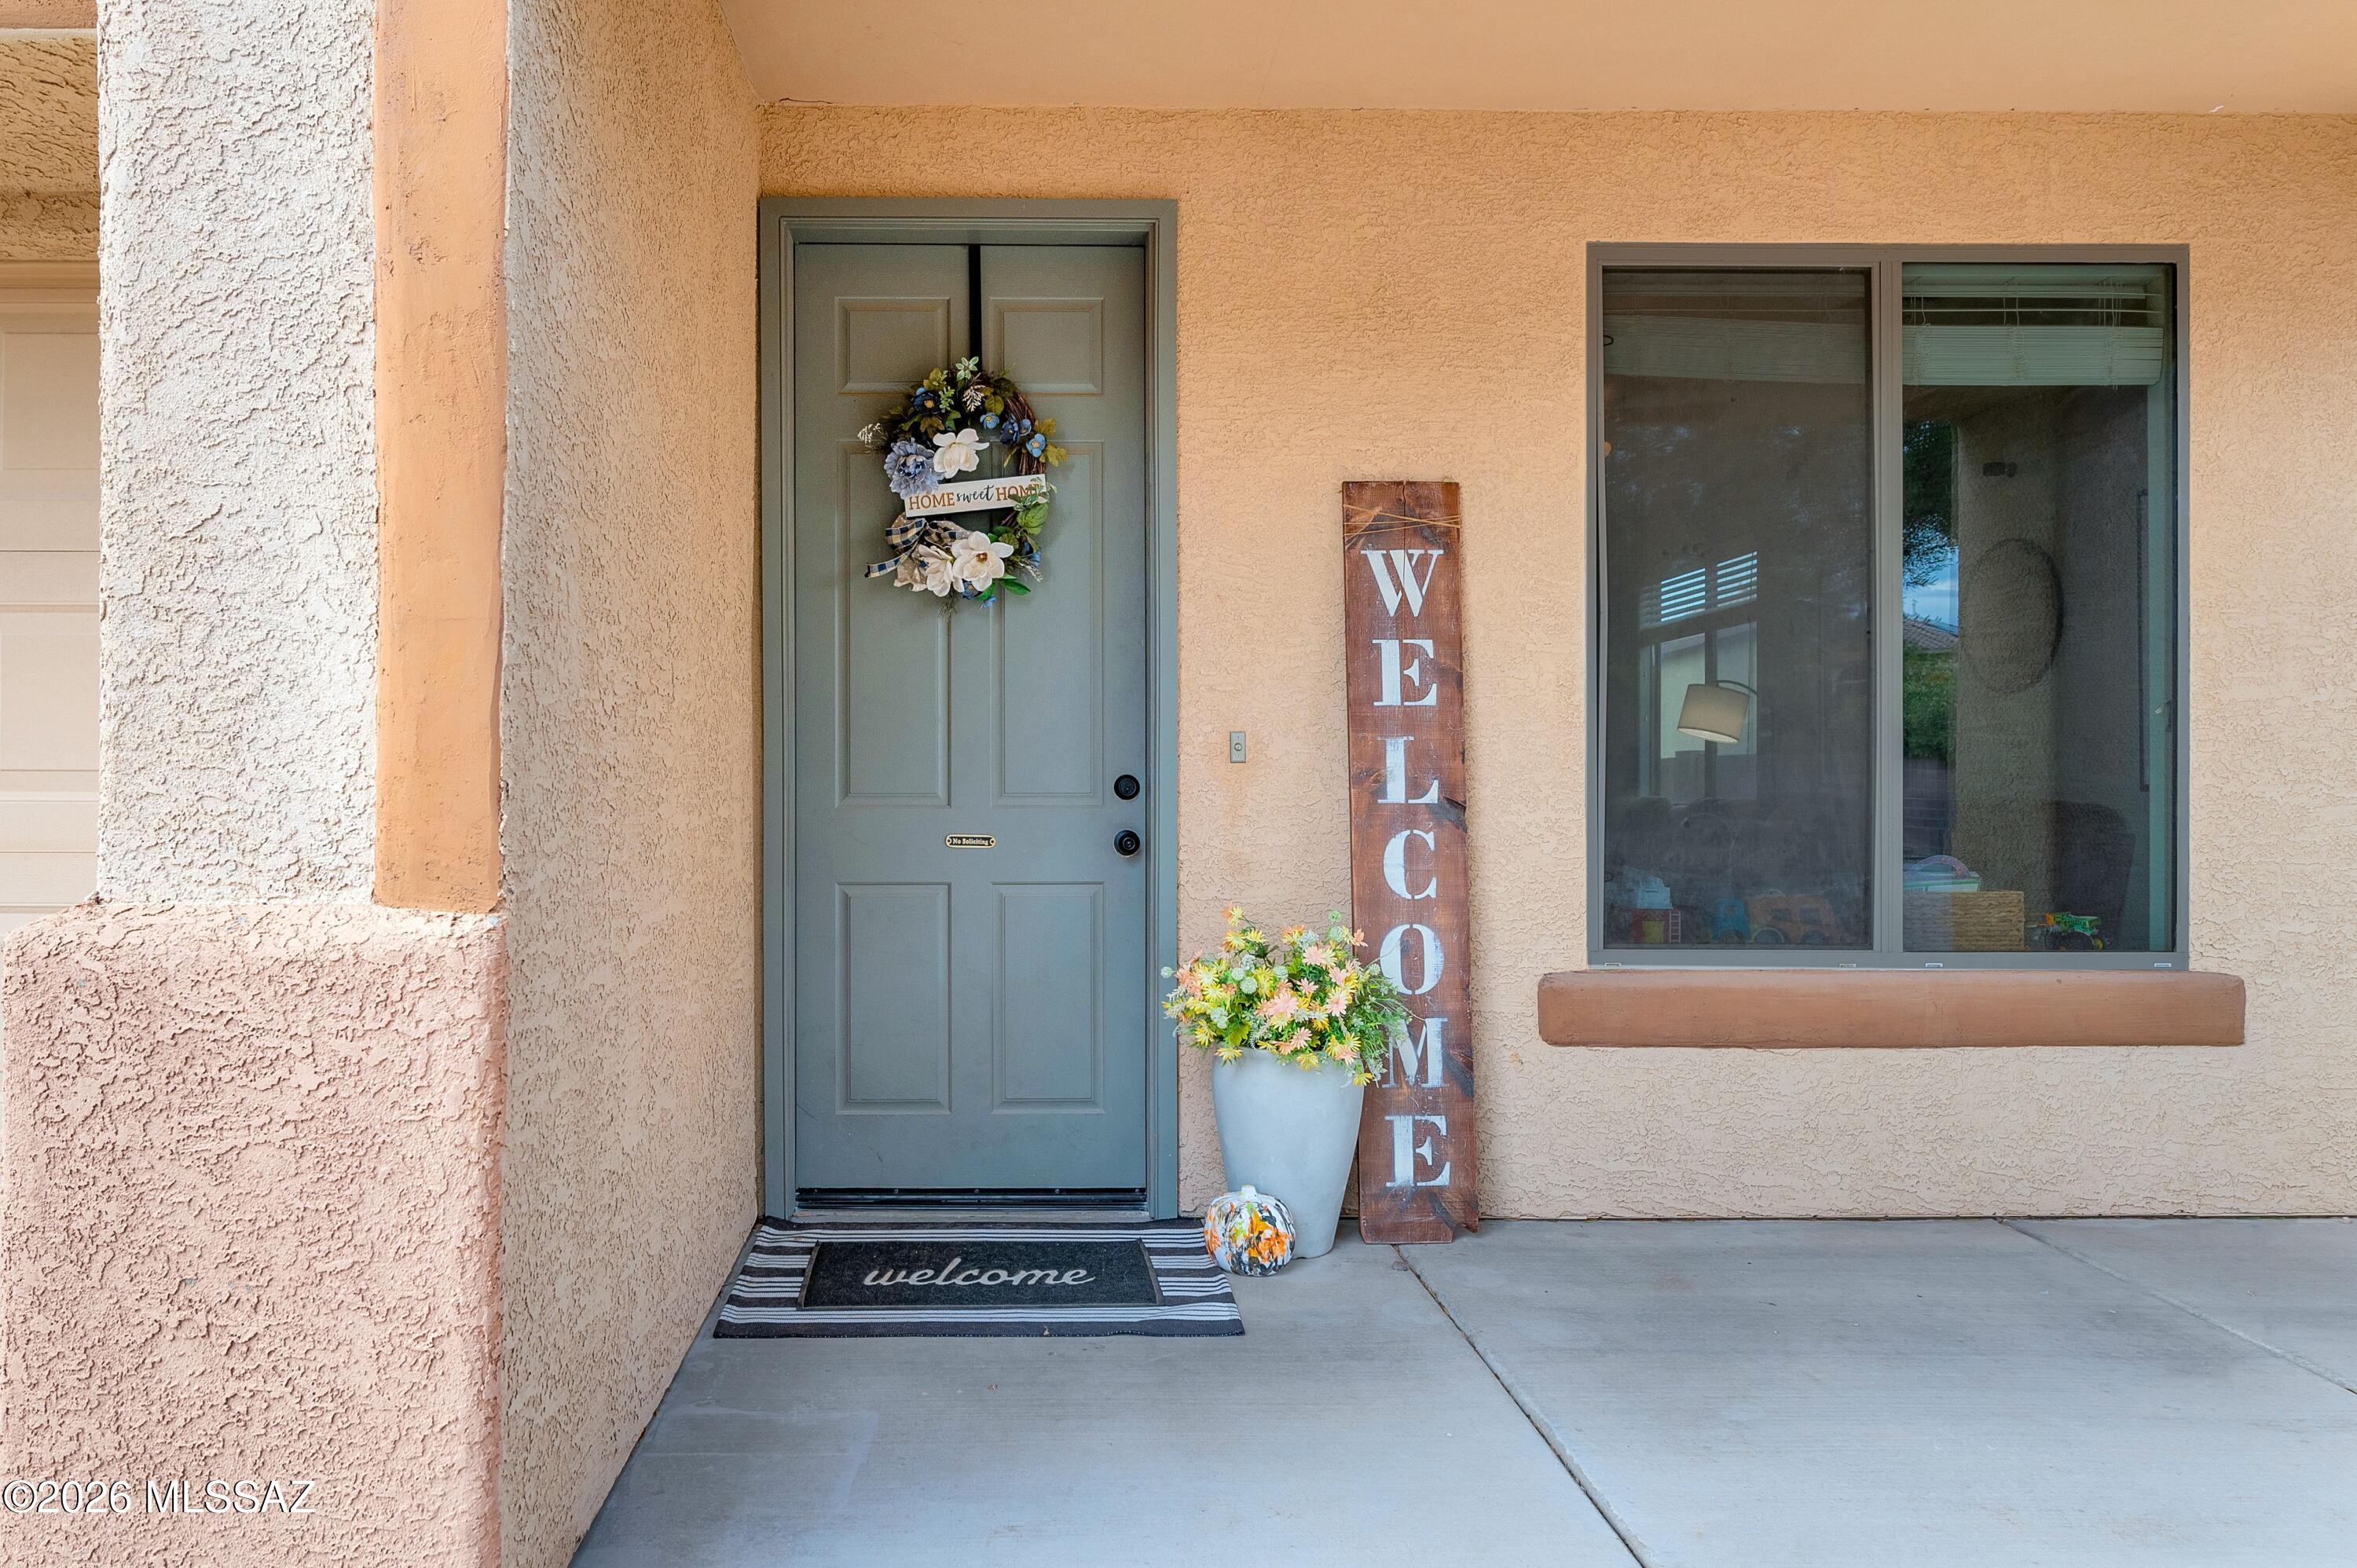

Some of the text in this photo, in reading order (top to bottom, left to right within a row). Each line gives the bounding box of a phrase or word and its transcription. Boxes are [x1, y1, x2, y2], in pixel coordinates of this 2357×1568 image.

[908, 483, 1044, 510] HOME sweet HOM
[962, 837, 989, 846] Soliciting
[1360, 549, 1452, 1189] WELCOME
[863, 1257, 1096, 1286] welcome
